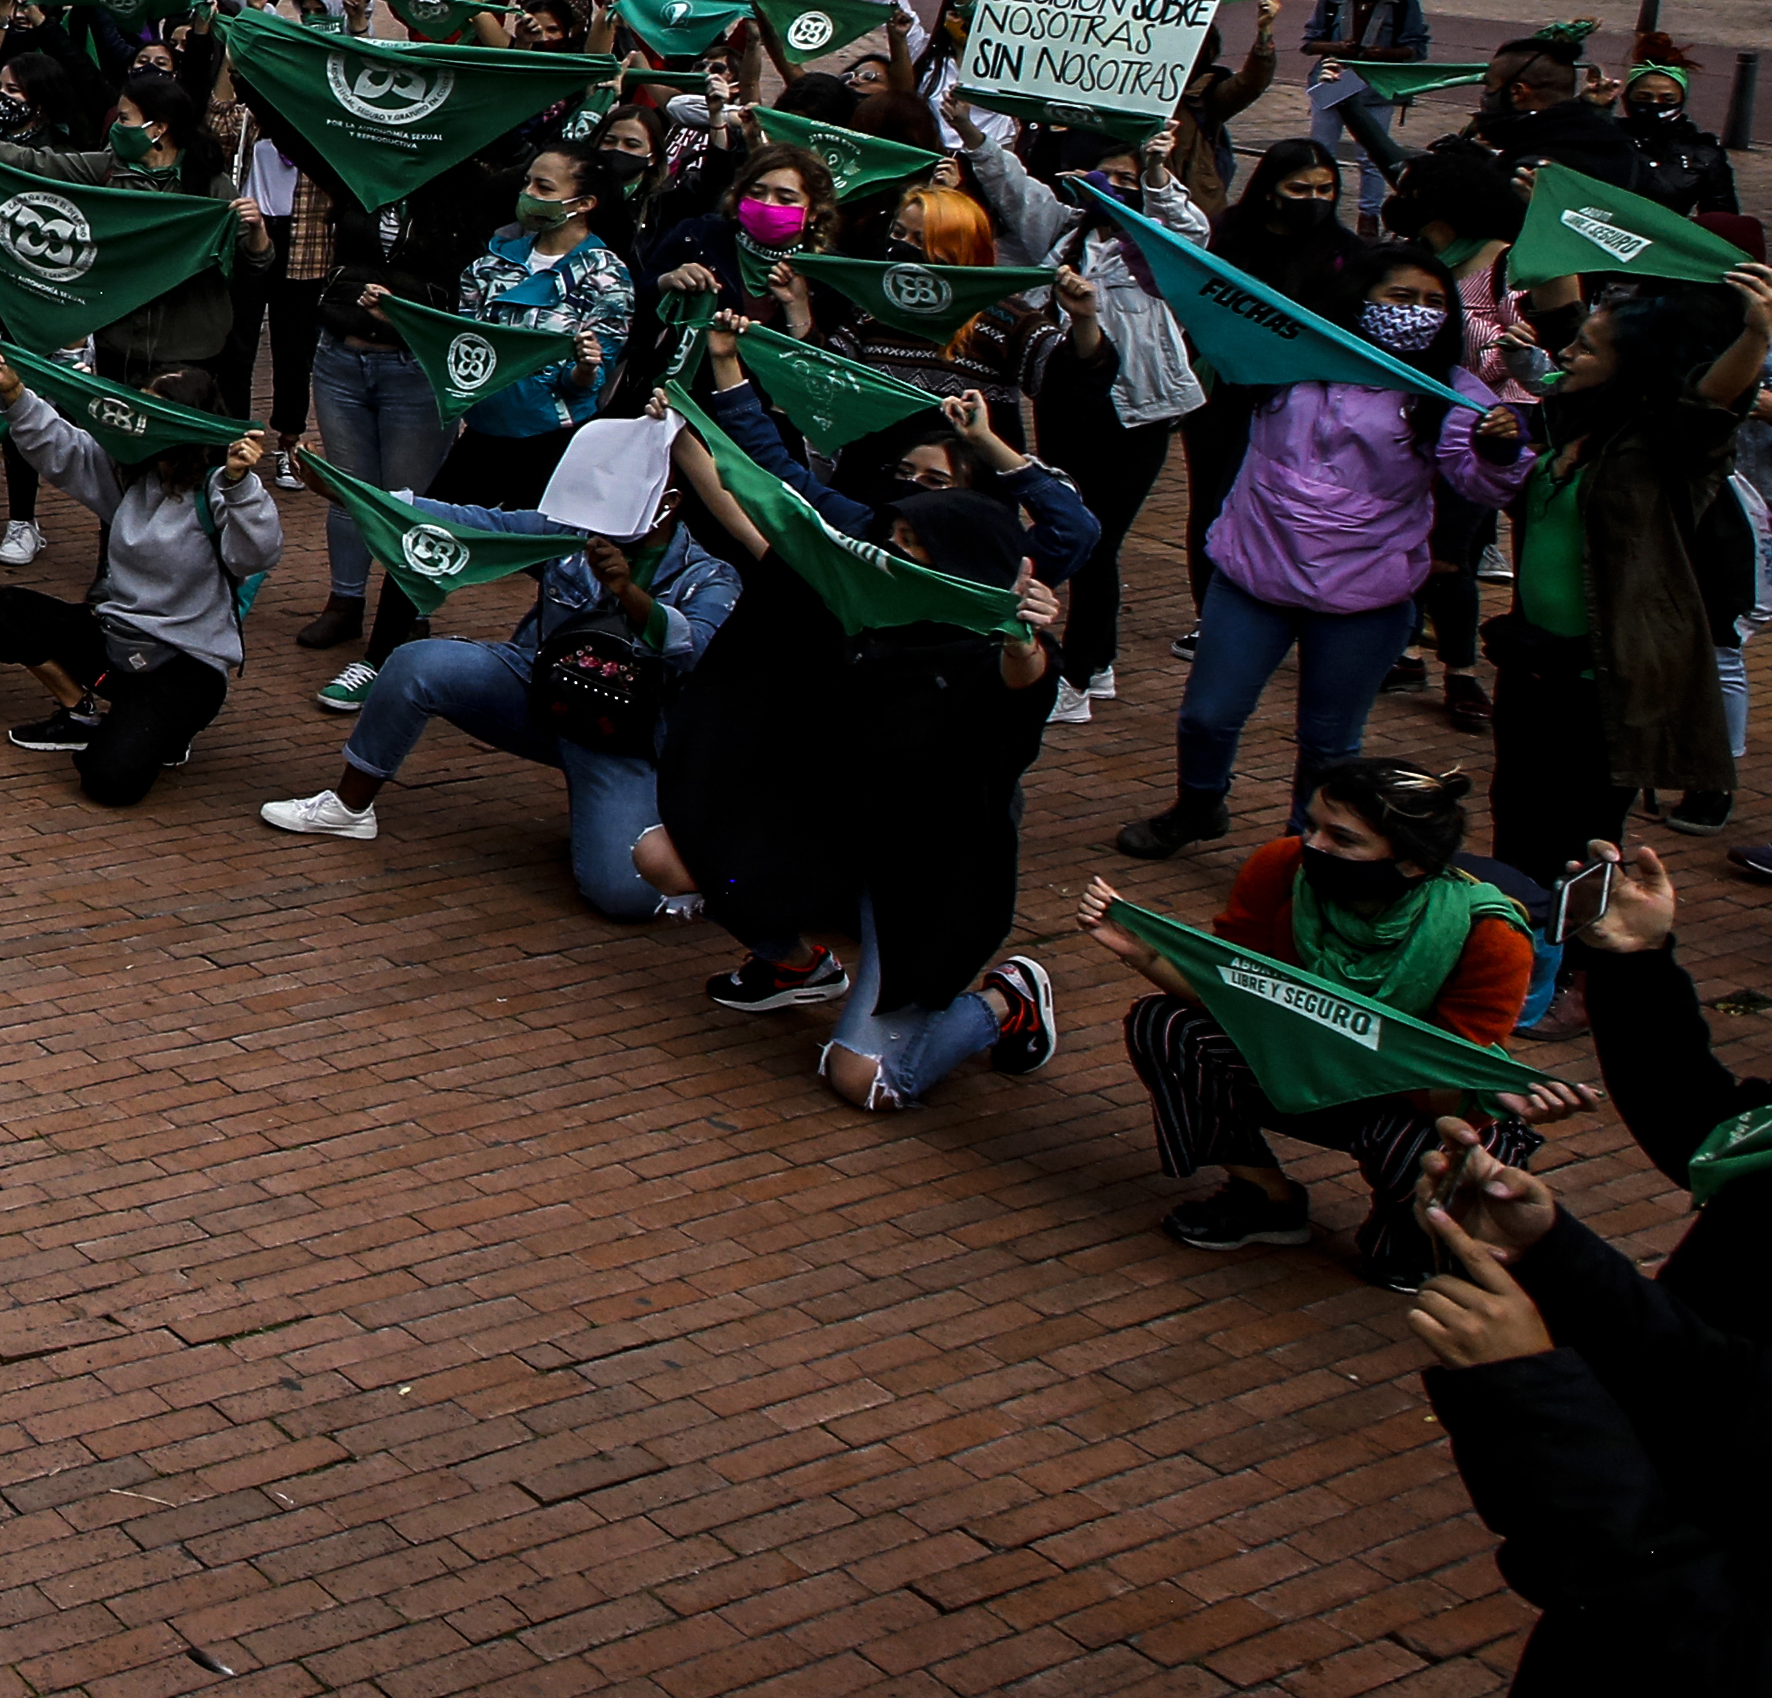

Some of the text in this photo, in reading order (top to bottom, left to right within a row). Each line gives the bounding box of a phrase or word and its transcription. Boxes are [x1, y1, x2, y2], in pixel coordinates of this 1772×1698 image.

[977, 4, 1157, 55] NOSOTRAS
[972, 38, 1185, 103] SIN NOSOTRAS
[1198, 277, 1309, 340] FUCHAS
[1231, 970, 1373, 1037] LIBRE Y SEGURO
